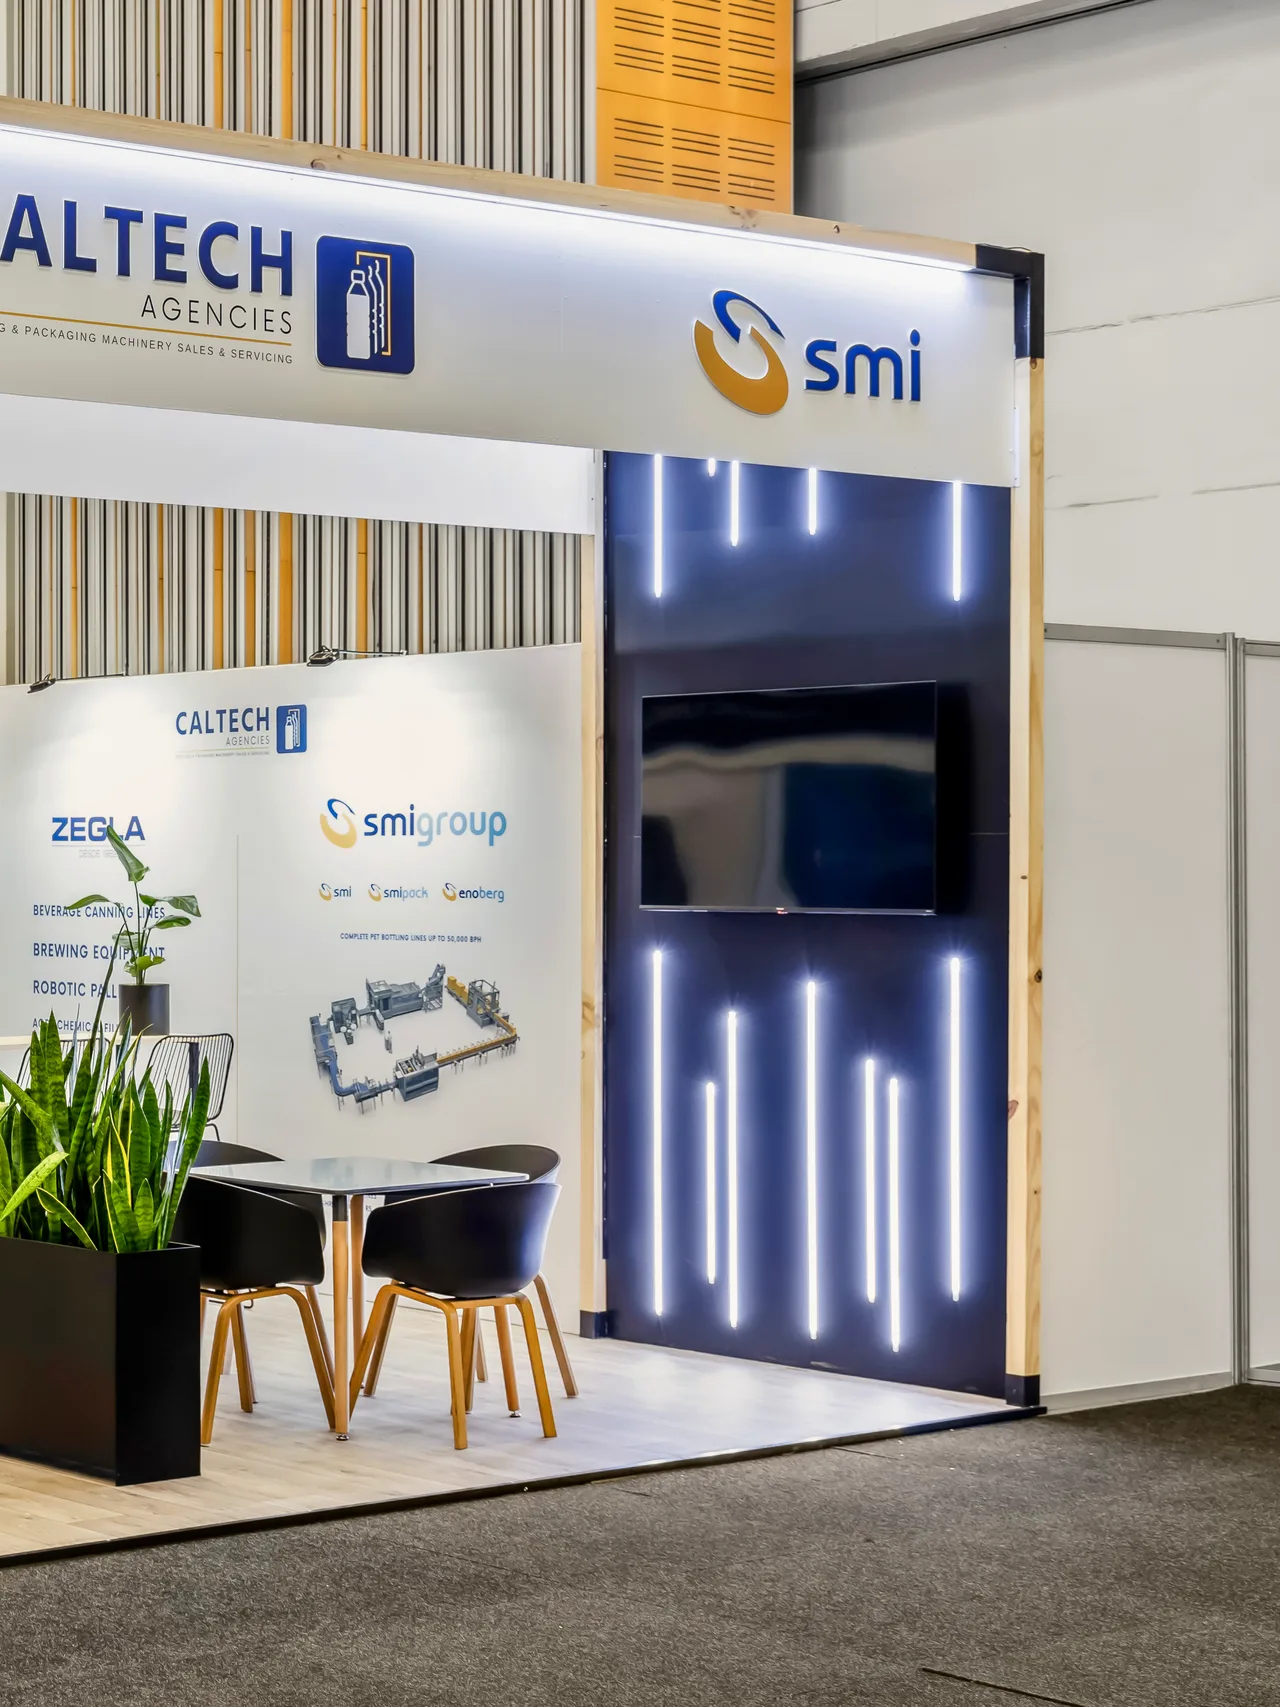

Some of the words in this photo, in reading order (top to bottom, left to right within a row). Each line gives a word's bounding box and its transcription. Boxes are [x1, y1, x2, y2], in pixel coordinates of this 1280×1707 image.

[140, 294, 294, 335] AGENCIES
[11, 324, 19, 334] &
[24, 325, 97, 343] PACKAGING
[101, 334, 172, 351] MACHINERY
[177, 343, 214, 356] SALES
[218, 347, 226, 357] &
[230, 349, 293, 364] SERVICING
[804, 328, 921, 402] smi
[175, 706, 270, 735] CALTECH
[225, 735, 270, 746] AGENCIES
[363, 803, 507, 847] smigroup
[333, 886, 352, 897] smi
[384, 886, 428, 901] smipack
[458, 886, 505, 903] enoberg
[33, 904, 81, 917] BEVERAGE
[340, 932, 369, 940] COMPLETE
[381, 933, 409, 941] BOTTLING
[33, 942, 88, 958] BREWING
[33, 980, 86, 997] ROBOTIC
[91, 984, 118, 998] PALL
